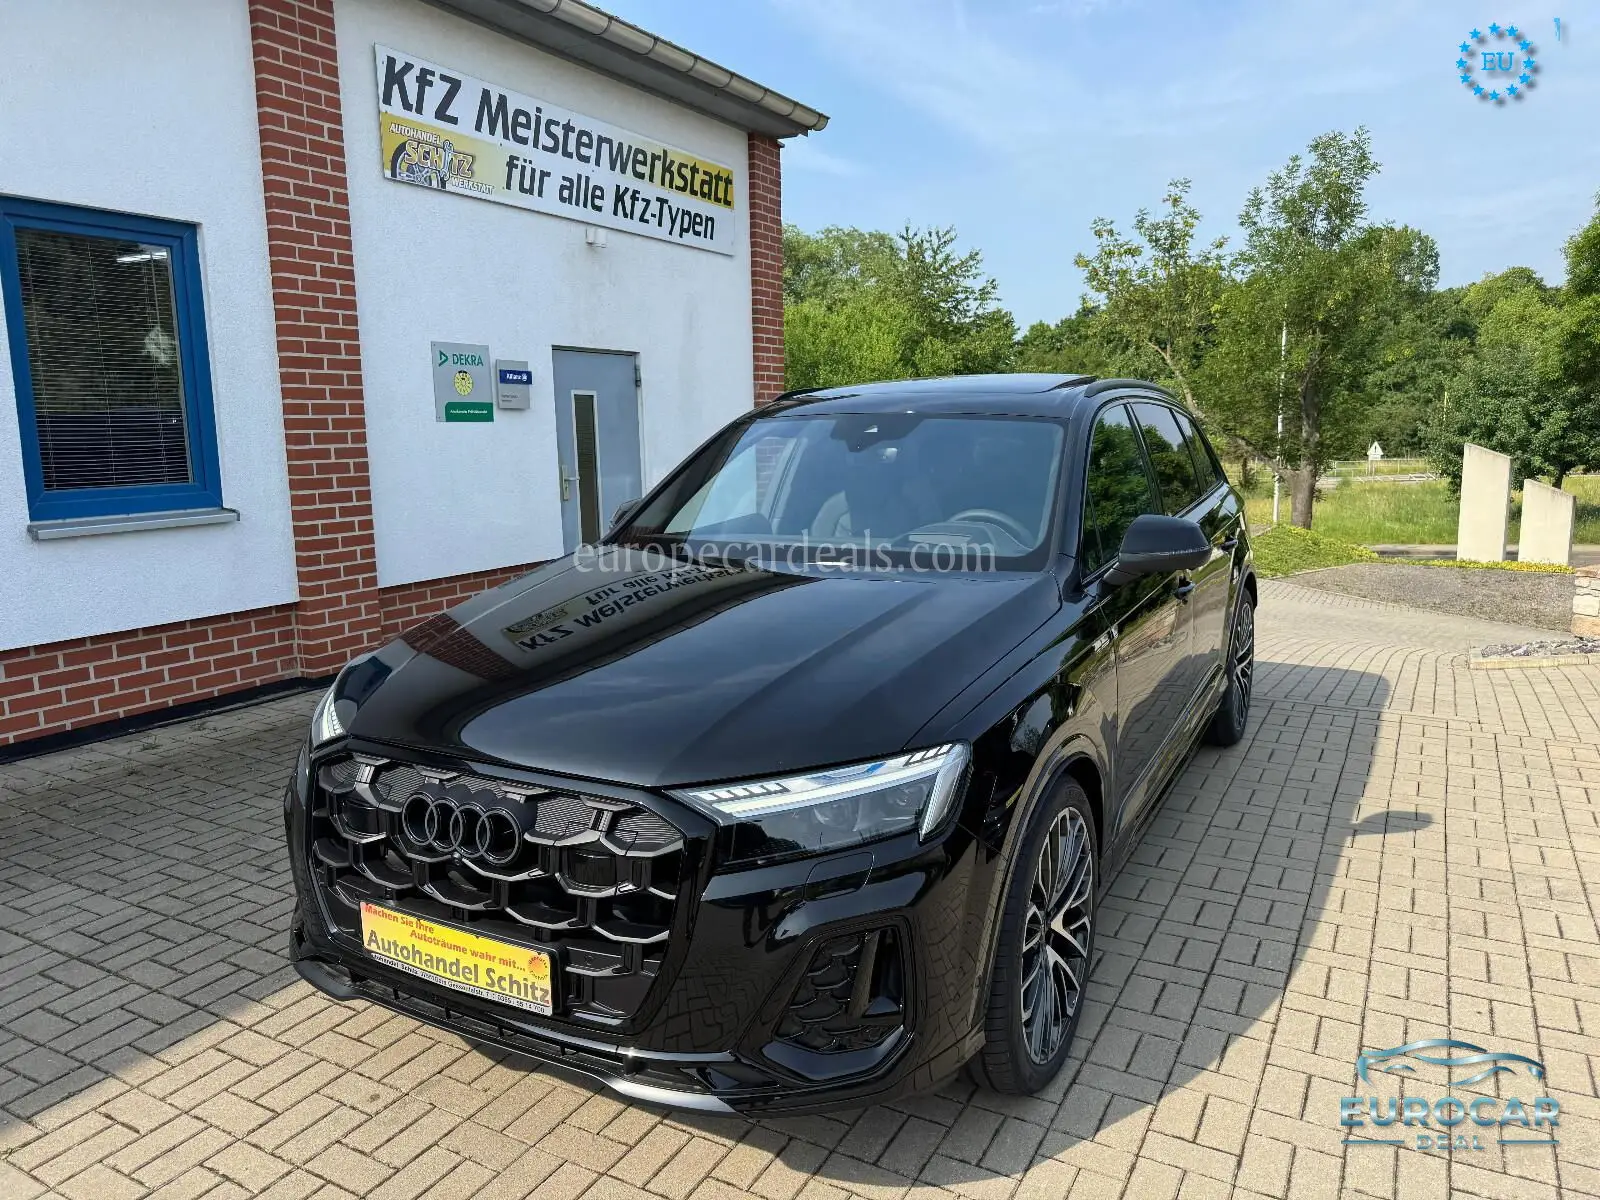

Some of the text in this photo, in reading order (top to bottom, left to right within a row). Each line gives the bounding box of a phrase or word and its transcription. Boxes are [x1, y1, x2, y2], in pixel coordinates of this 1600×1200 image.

[382, 55, 734, 207] KfZ Meisterwerkstatt
[389, 122, 441, 145] AUTOHANDEL
[506, 154, 716, 239] für alle Kfz-Typen
[452, 353, 484, 366] DEKRA
[365, 903, 434, 934] Machen Sie Ihre
[410, 929, 468, 954] Autoträume
[469, 948, 497, 963] wahr
[366, 929, 479, 983] Autohandel
[485, 967, 550, 1003] Schitz
